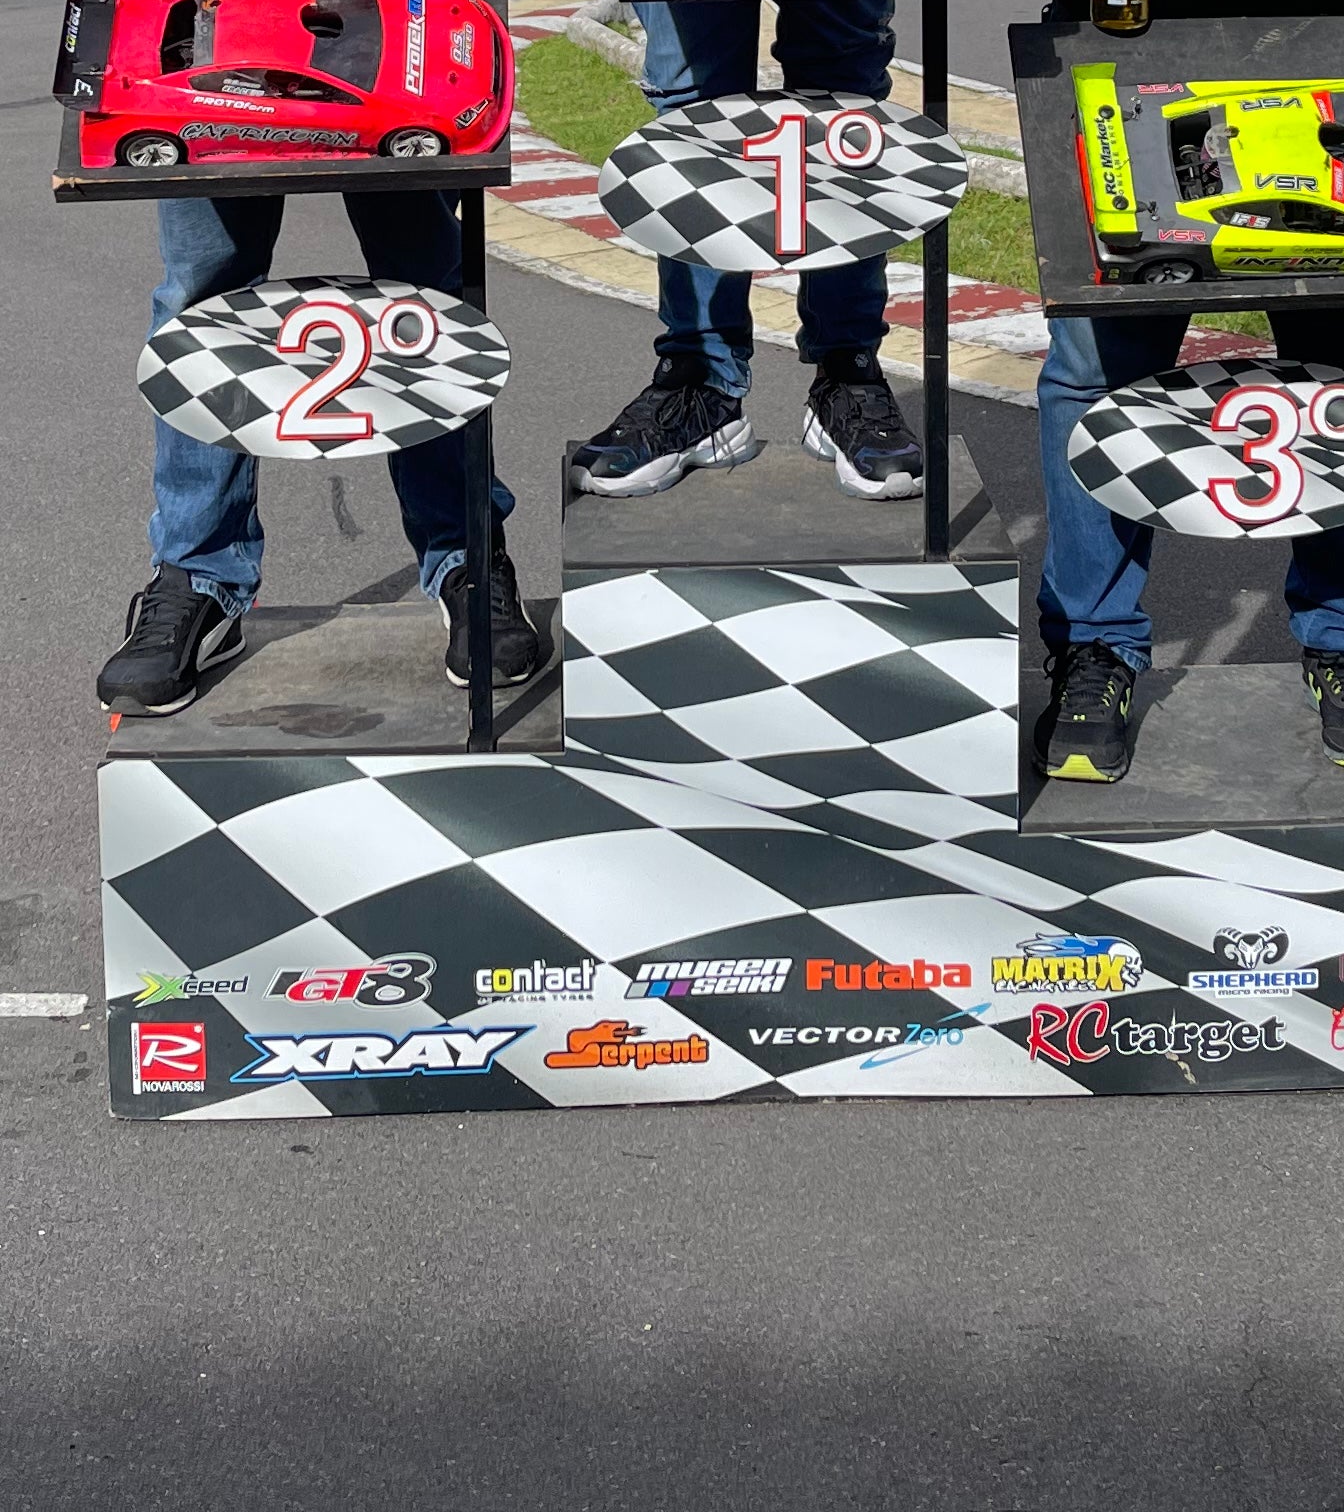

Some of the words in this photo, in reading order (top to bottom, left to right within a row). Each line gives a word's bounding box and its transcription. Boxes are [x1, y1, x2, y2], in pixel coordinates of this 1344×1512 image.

[64, 1, 82, 53] contact
[192, 95, 275, 114] PROTOform
[179, 122, 358, 146] CAPRICORN
[1094, 117, 1113, 168] Market
[1103, 171, 1117, 195] RC
[1254, 173, 1319, 192] VSR
[1158, 228, 1206, 242] VSR
[474, 958, 596, 993] contact
[805, 958, 973, 991] Futaba
[991, 954, 1127, 991] MATRIX
[1192, 970, 1317, 989] SHEPHERD
[1218, 988, 1251, 996] micro
[1253, 988, 1290, 996] racing
[253, 1029, 520, 1076] XRAY
[544, 1019, 710, 1069] Serpent
[142, 1080, 205, 1093] NOVAROSSI
